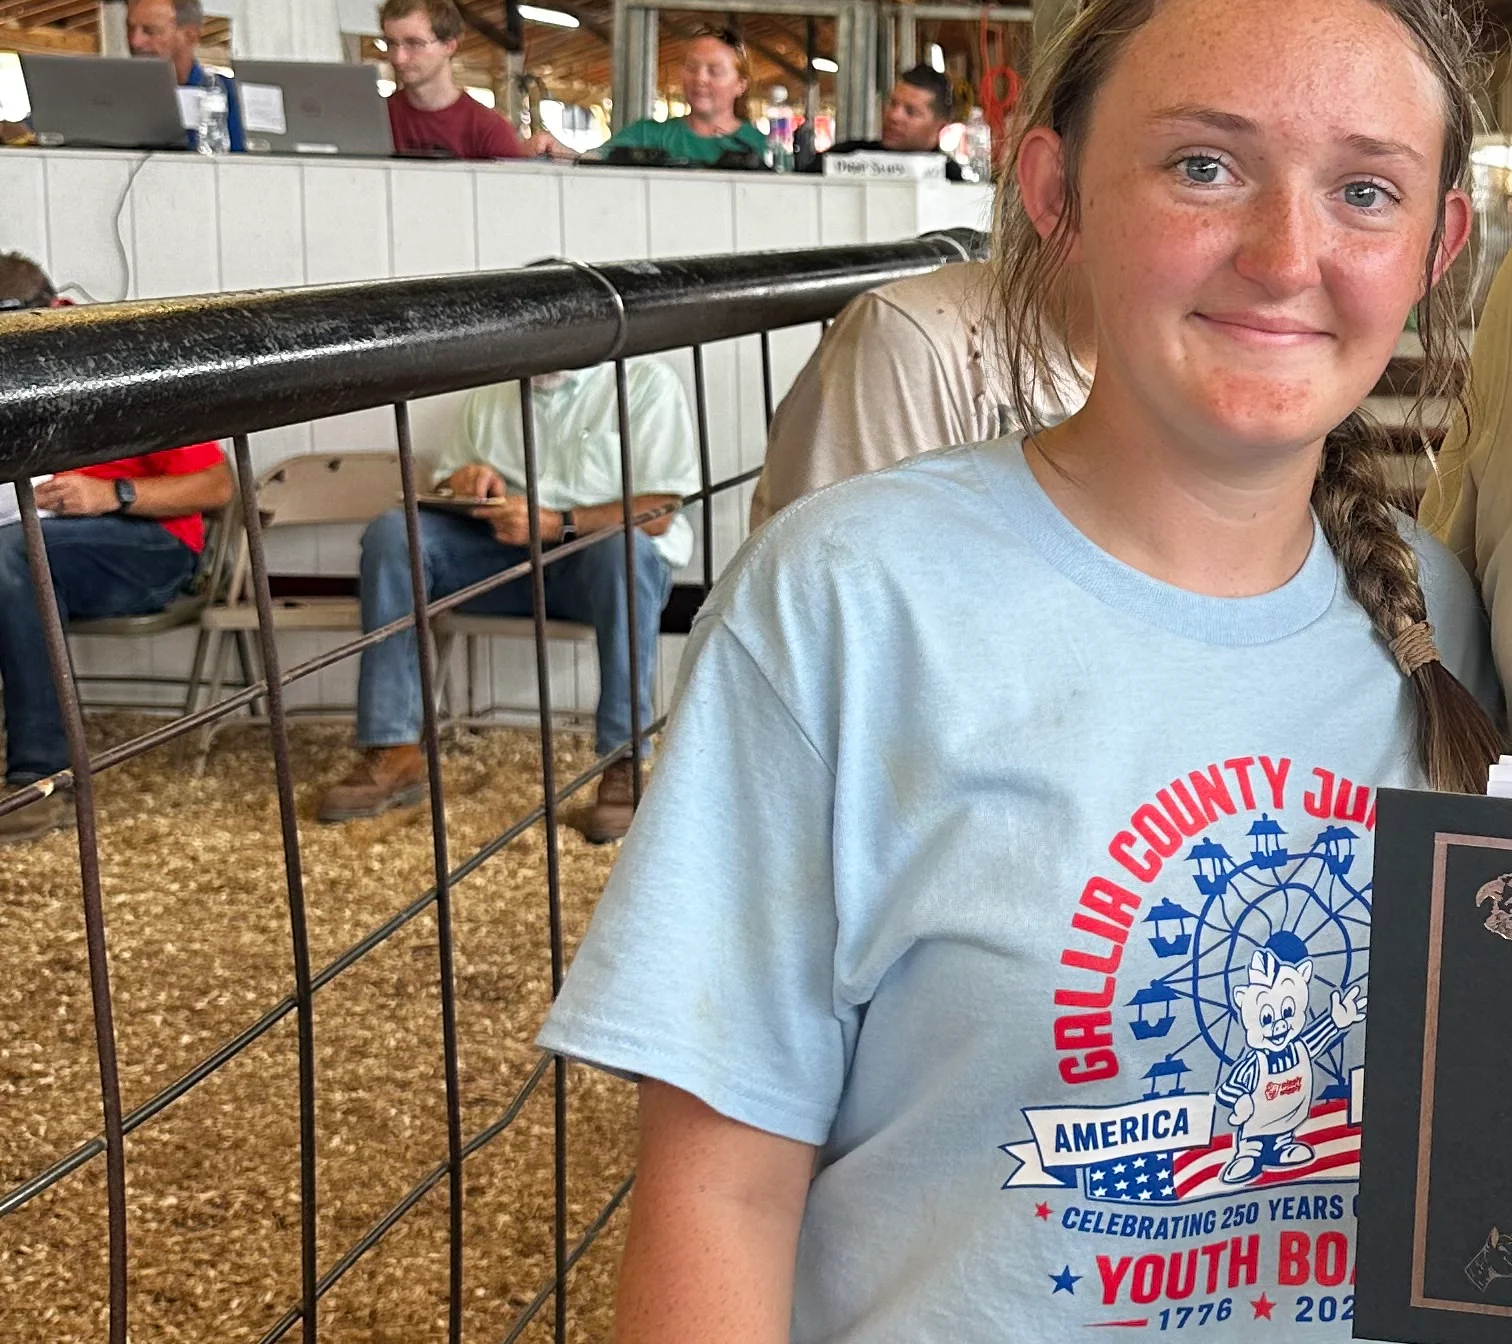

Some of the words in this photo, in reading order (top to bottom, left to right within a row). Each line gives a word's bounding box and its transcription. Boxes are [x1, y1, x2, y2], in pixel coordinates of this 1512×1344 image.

[1053, 875, 1142, 1084] GALLIA
[1108, 755, 1291, 883] COUNTY
[1055, 1107, 1189, 1153] AMERICA
[1061, 1206, 1216, 1240] CELEBRATING
[1221, 1202, 1258, 1229] 250
[1269, 1194, 1343, 1221] YEARS
[1096, 1234, 1259, 1305] YOUTH
[1278, 1231, 1356, 1286] BO
[1159, 1298, 1232, 1330] 1776
